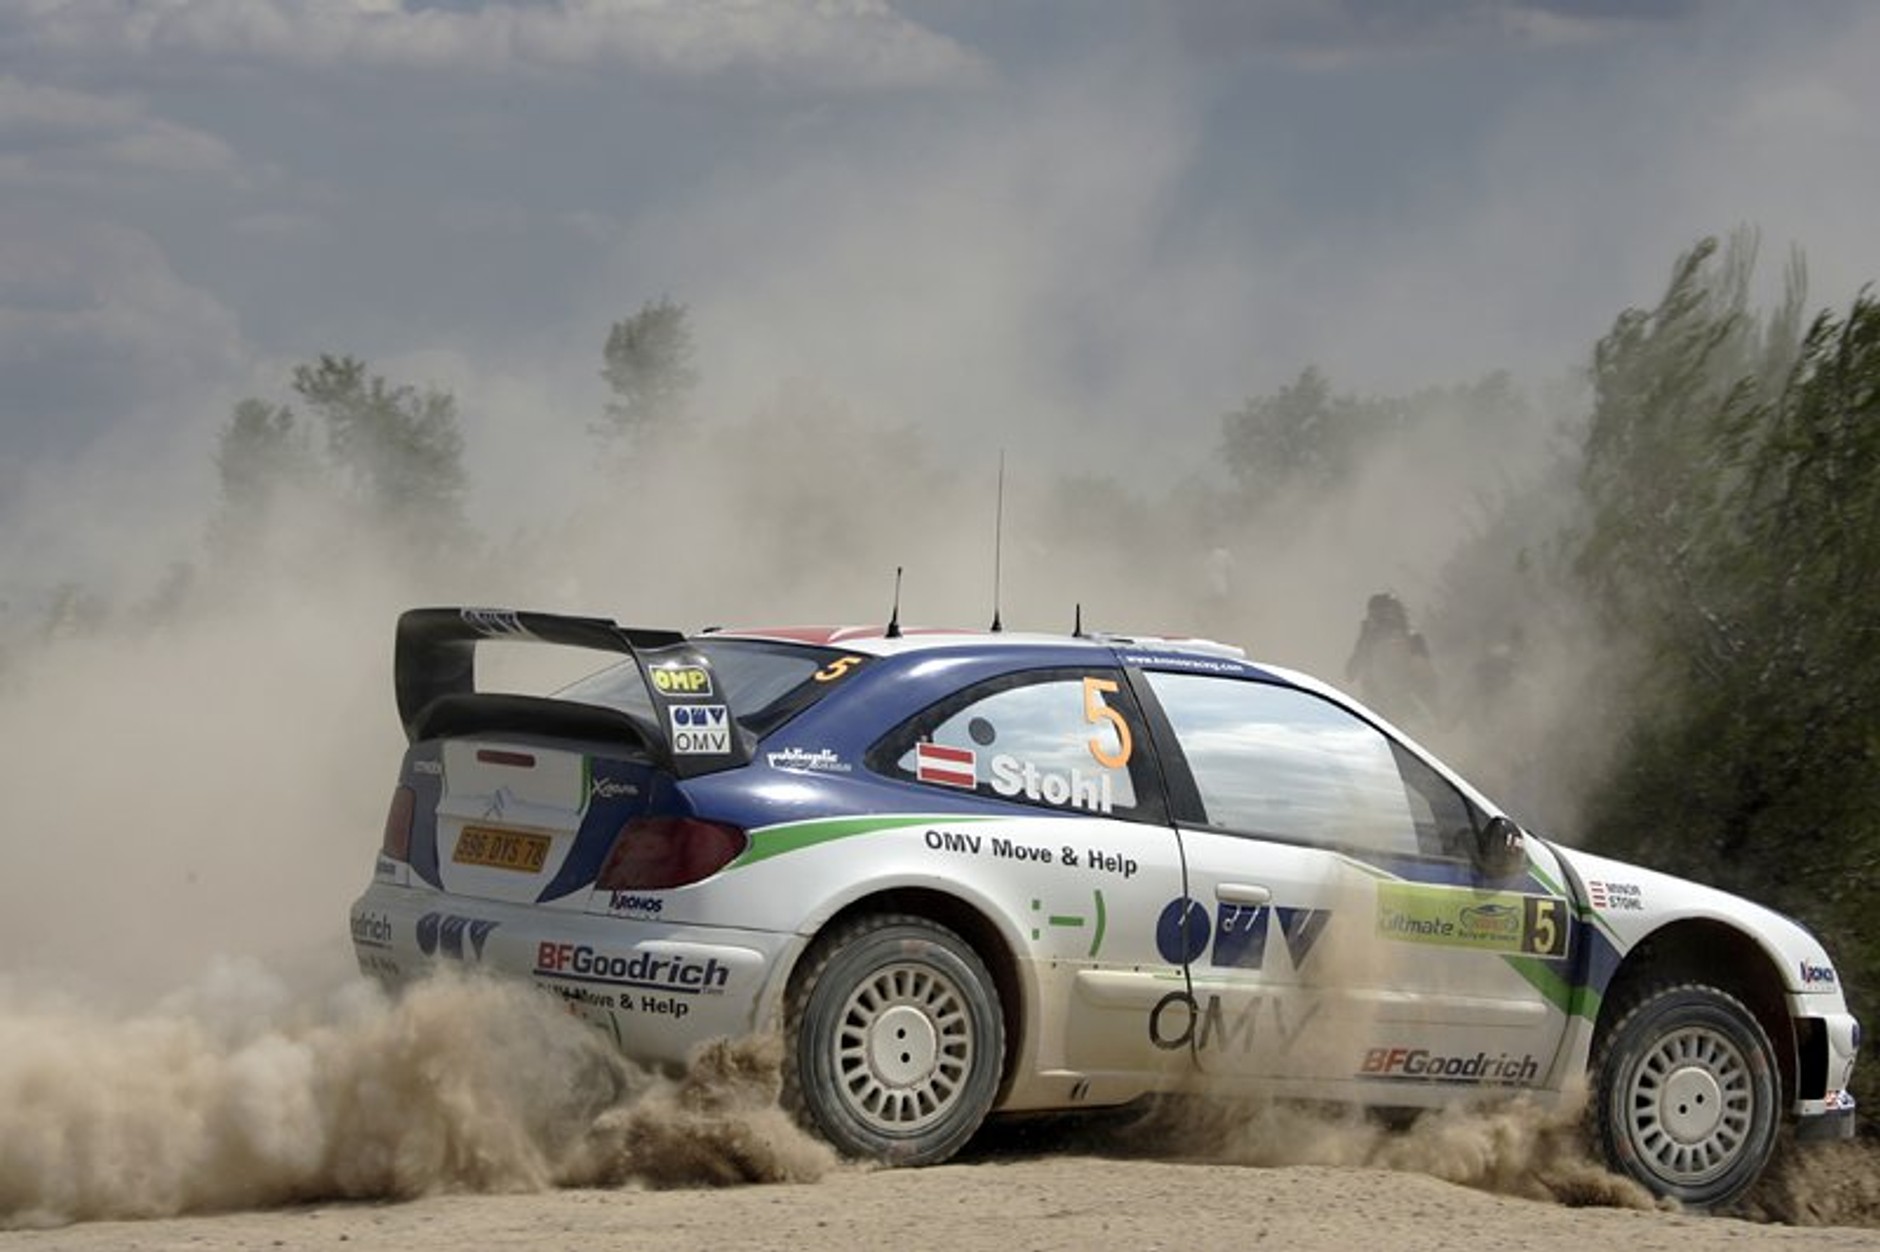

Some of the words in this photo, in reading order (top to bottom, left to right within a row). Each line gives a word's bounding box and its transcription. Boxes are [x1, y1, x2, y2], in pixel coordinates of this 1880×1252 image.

[655, 669, 706, 691] OMP
[814, 656, 862, 681] 5
[676, 733, 726, 751] OMV
[1083, 676, 1133, 768] 5
[991, 754, 1112, 813] Stohl
[925, 830, 982, 855] OMV
[991, 837, 1052, 864] Move
[1061, 846, 1079, 867] &
[1088, 850, 1137, 879] Help
[1533, 900, 1556, 954] 5
[538, 941, 730, 986] BFGoodrich
[619, 994, 634, 1011] &
[641, 996, 688, 1018] Help
[1150, 991, 1321, 1054] OMV
[1361, 1047, 1539, 1079] BFGoodrich
